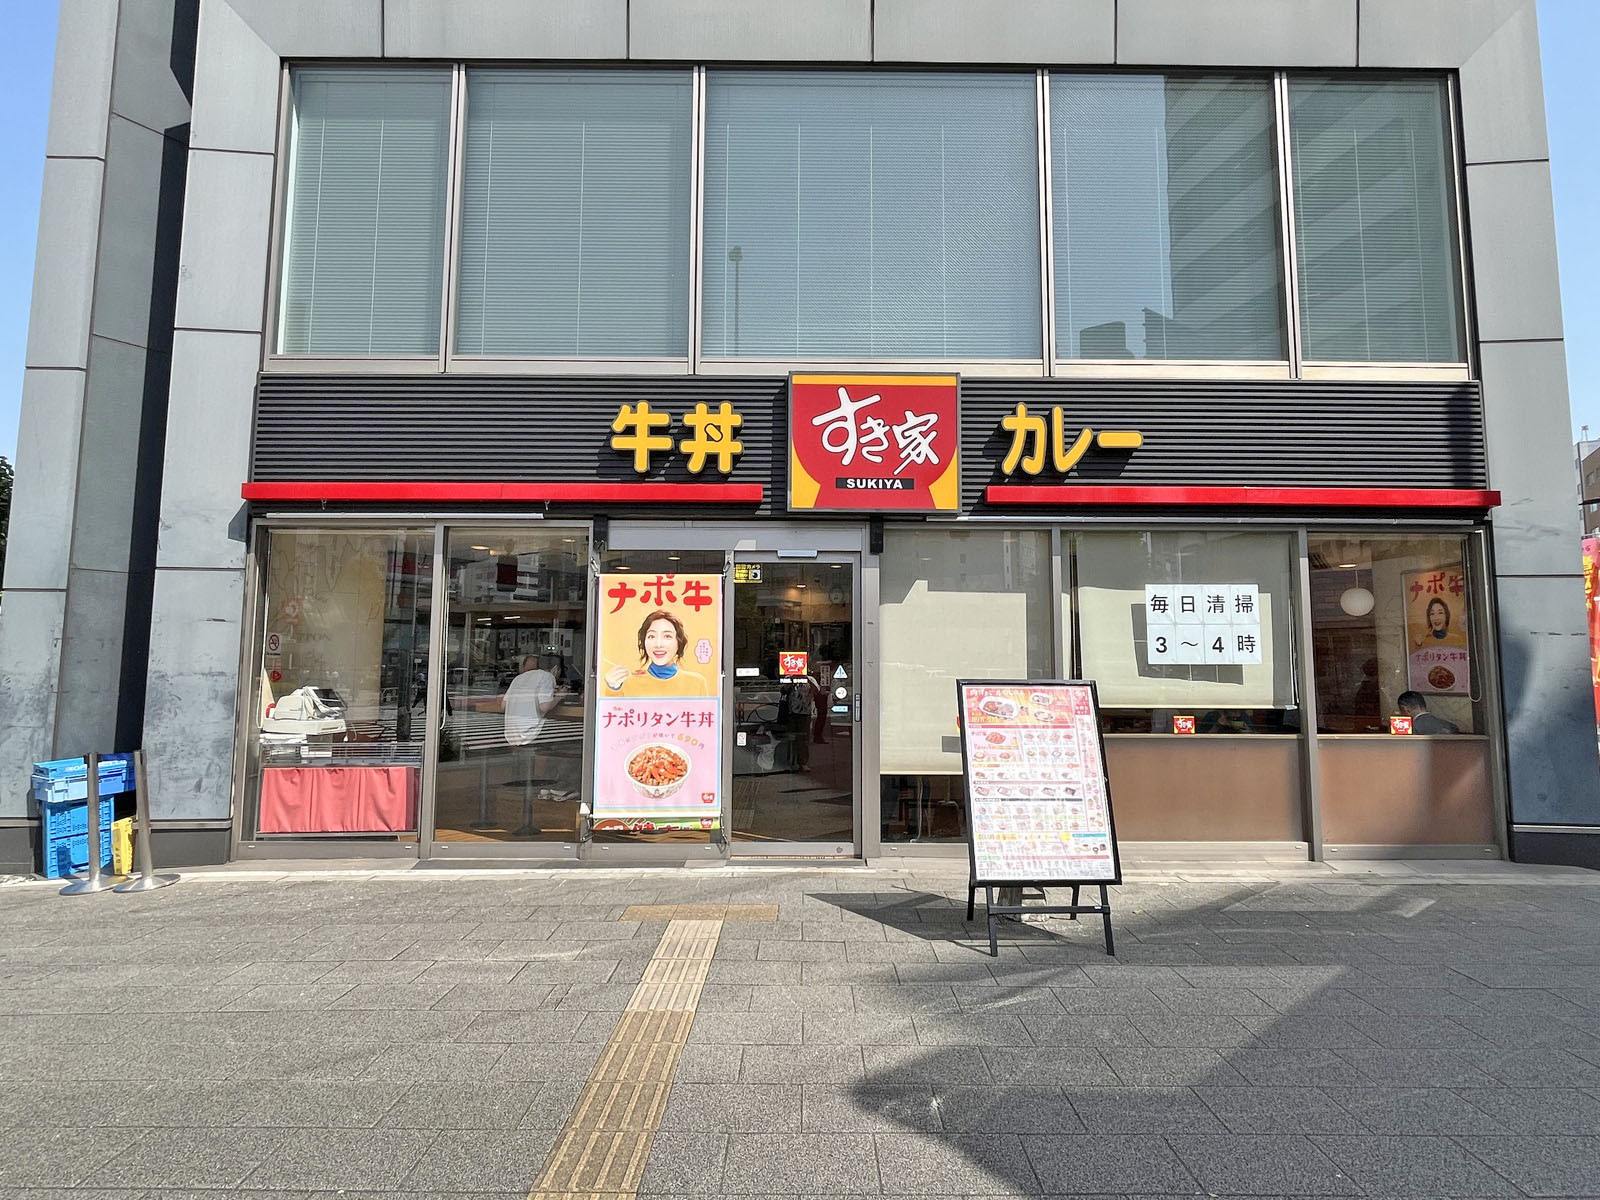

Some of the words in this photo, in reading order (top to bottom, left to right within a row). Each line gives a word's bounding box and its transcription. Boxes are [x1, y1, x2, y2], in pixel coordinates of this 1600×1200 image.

[611, 400, 745, 474] 牛丼
[811, 387, 940, 475] すき家
[1001, 401, 1144, 475] カレー
[846, 478, 903, 489] SUKIYA
[607, 573, 713, 614] ナポ牛
[1150, 594, 1254, 614] 毎日清掃
[1410, 572, 1464, 602] ナポ牛
[602, 708, 714, 728] ナポリタン牛丼
